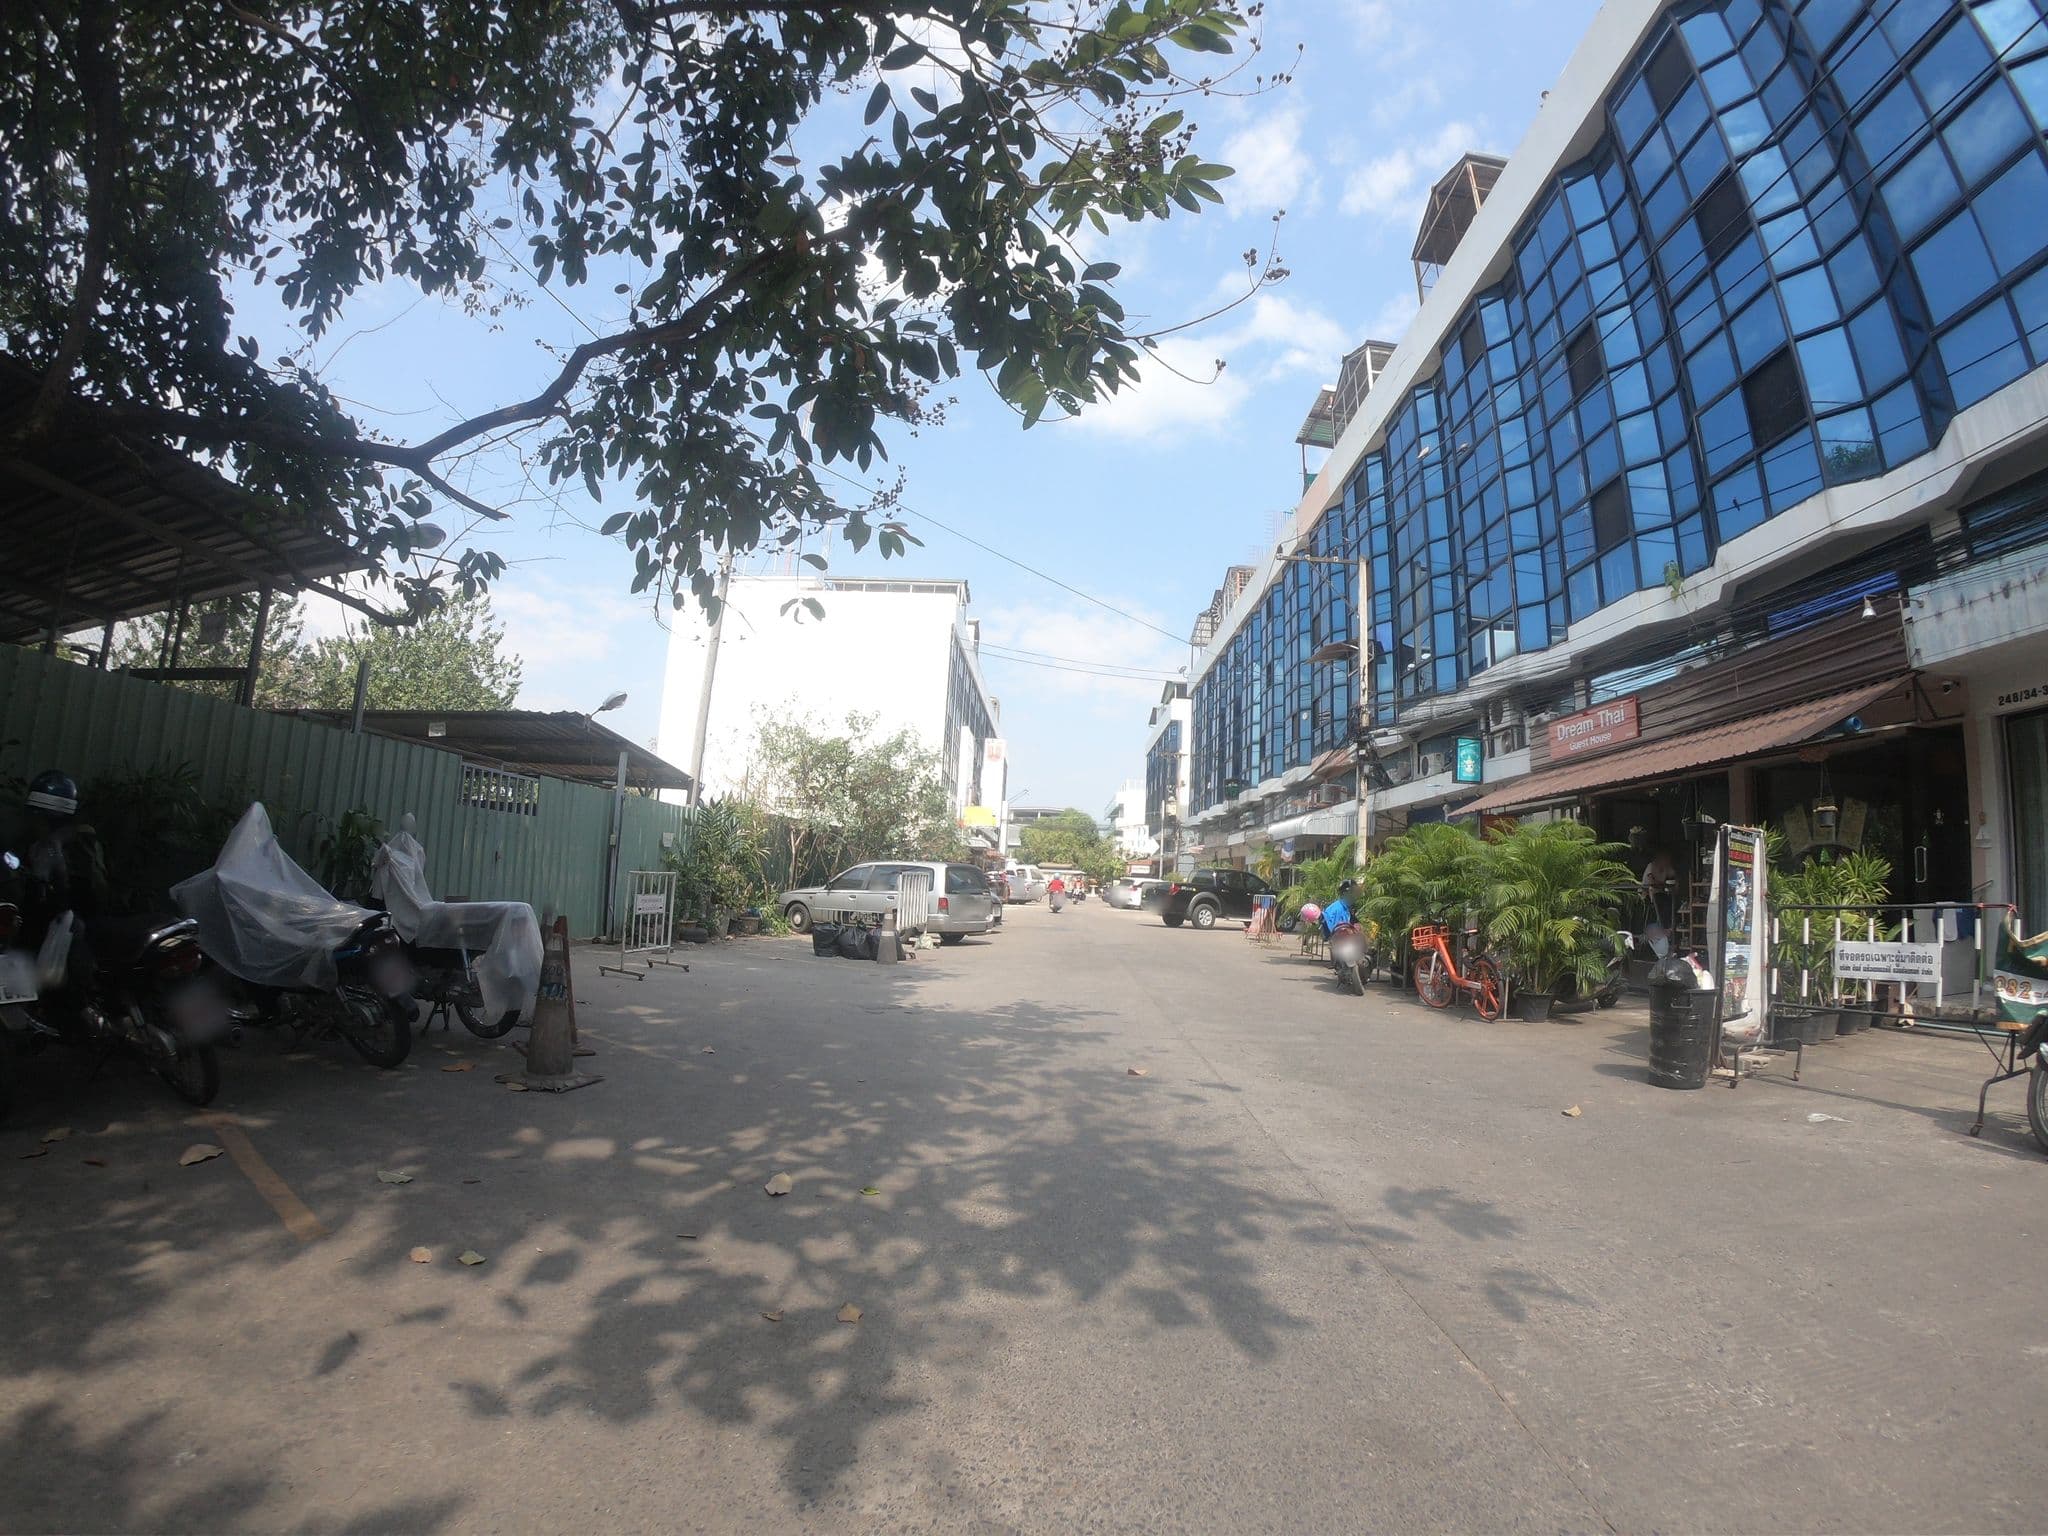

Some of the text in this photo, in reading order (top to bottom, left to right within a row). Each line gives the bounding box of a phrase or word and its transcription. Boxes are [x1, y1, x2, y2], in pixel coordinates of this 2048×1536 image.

[1557, 704, 1625, 741] Dream Thai
[1569, 732, 1612, 751] Guest House
